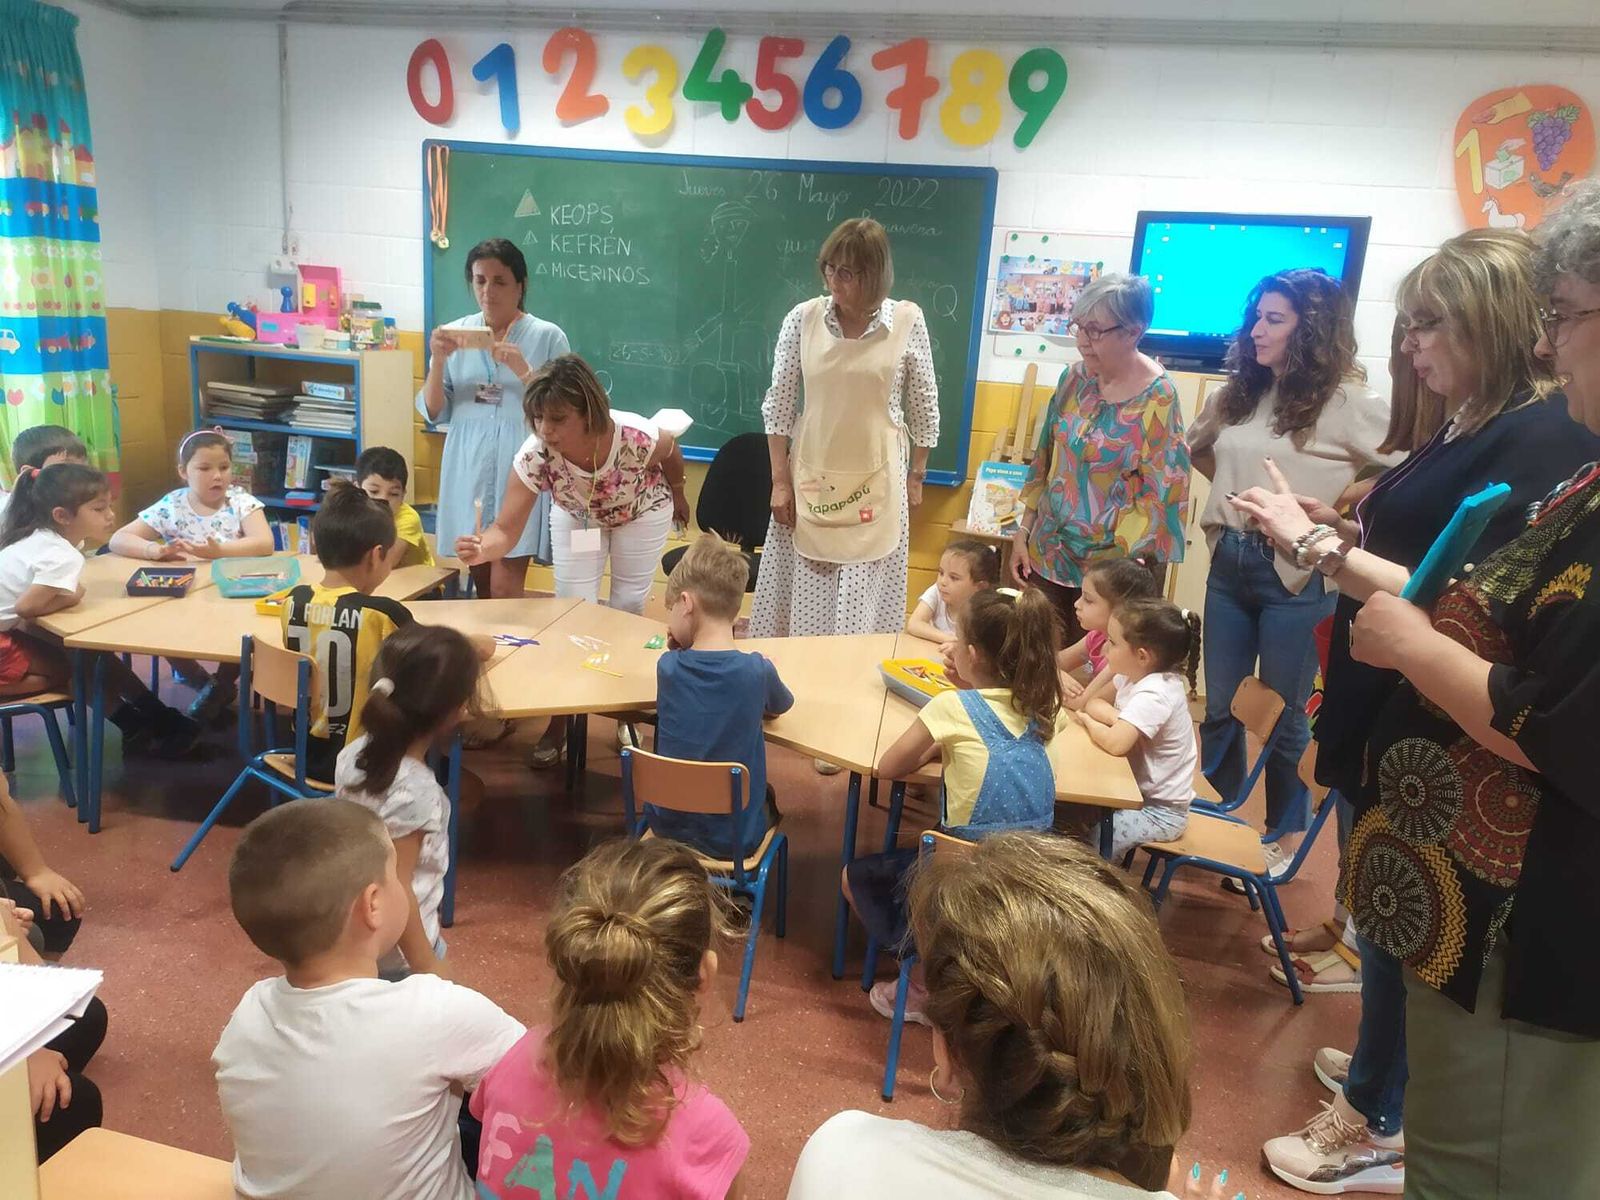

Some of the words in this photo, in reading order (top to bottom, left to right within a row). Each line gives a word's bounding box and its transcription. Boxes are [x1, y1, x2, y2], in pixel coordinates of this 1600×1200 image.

[407, 38, 453, 124] 0
[472, 43, 520, 131] 1
[542, 28, 609, 120] 2
[622, 44, 678, 135] 3
[682, 28, 753, 121] 4
[745, 36, 804, 130] 5
[803, 35, 862, 130] 6
[872, 38, 940, 140] 7
[939, 50, 1006, 146] 8
[1008, 47, 1068, 148] 9
[1456, 128, 1483, 194] 1
[550, 203, 614, 225] KEOPS
[798, 173, 852, 222] Mayo
[875, 177, 940, 209] 2022
[550, 227, 631, 257] KEFRÉN
[480, 1111, 628, 1200] FAN
